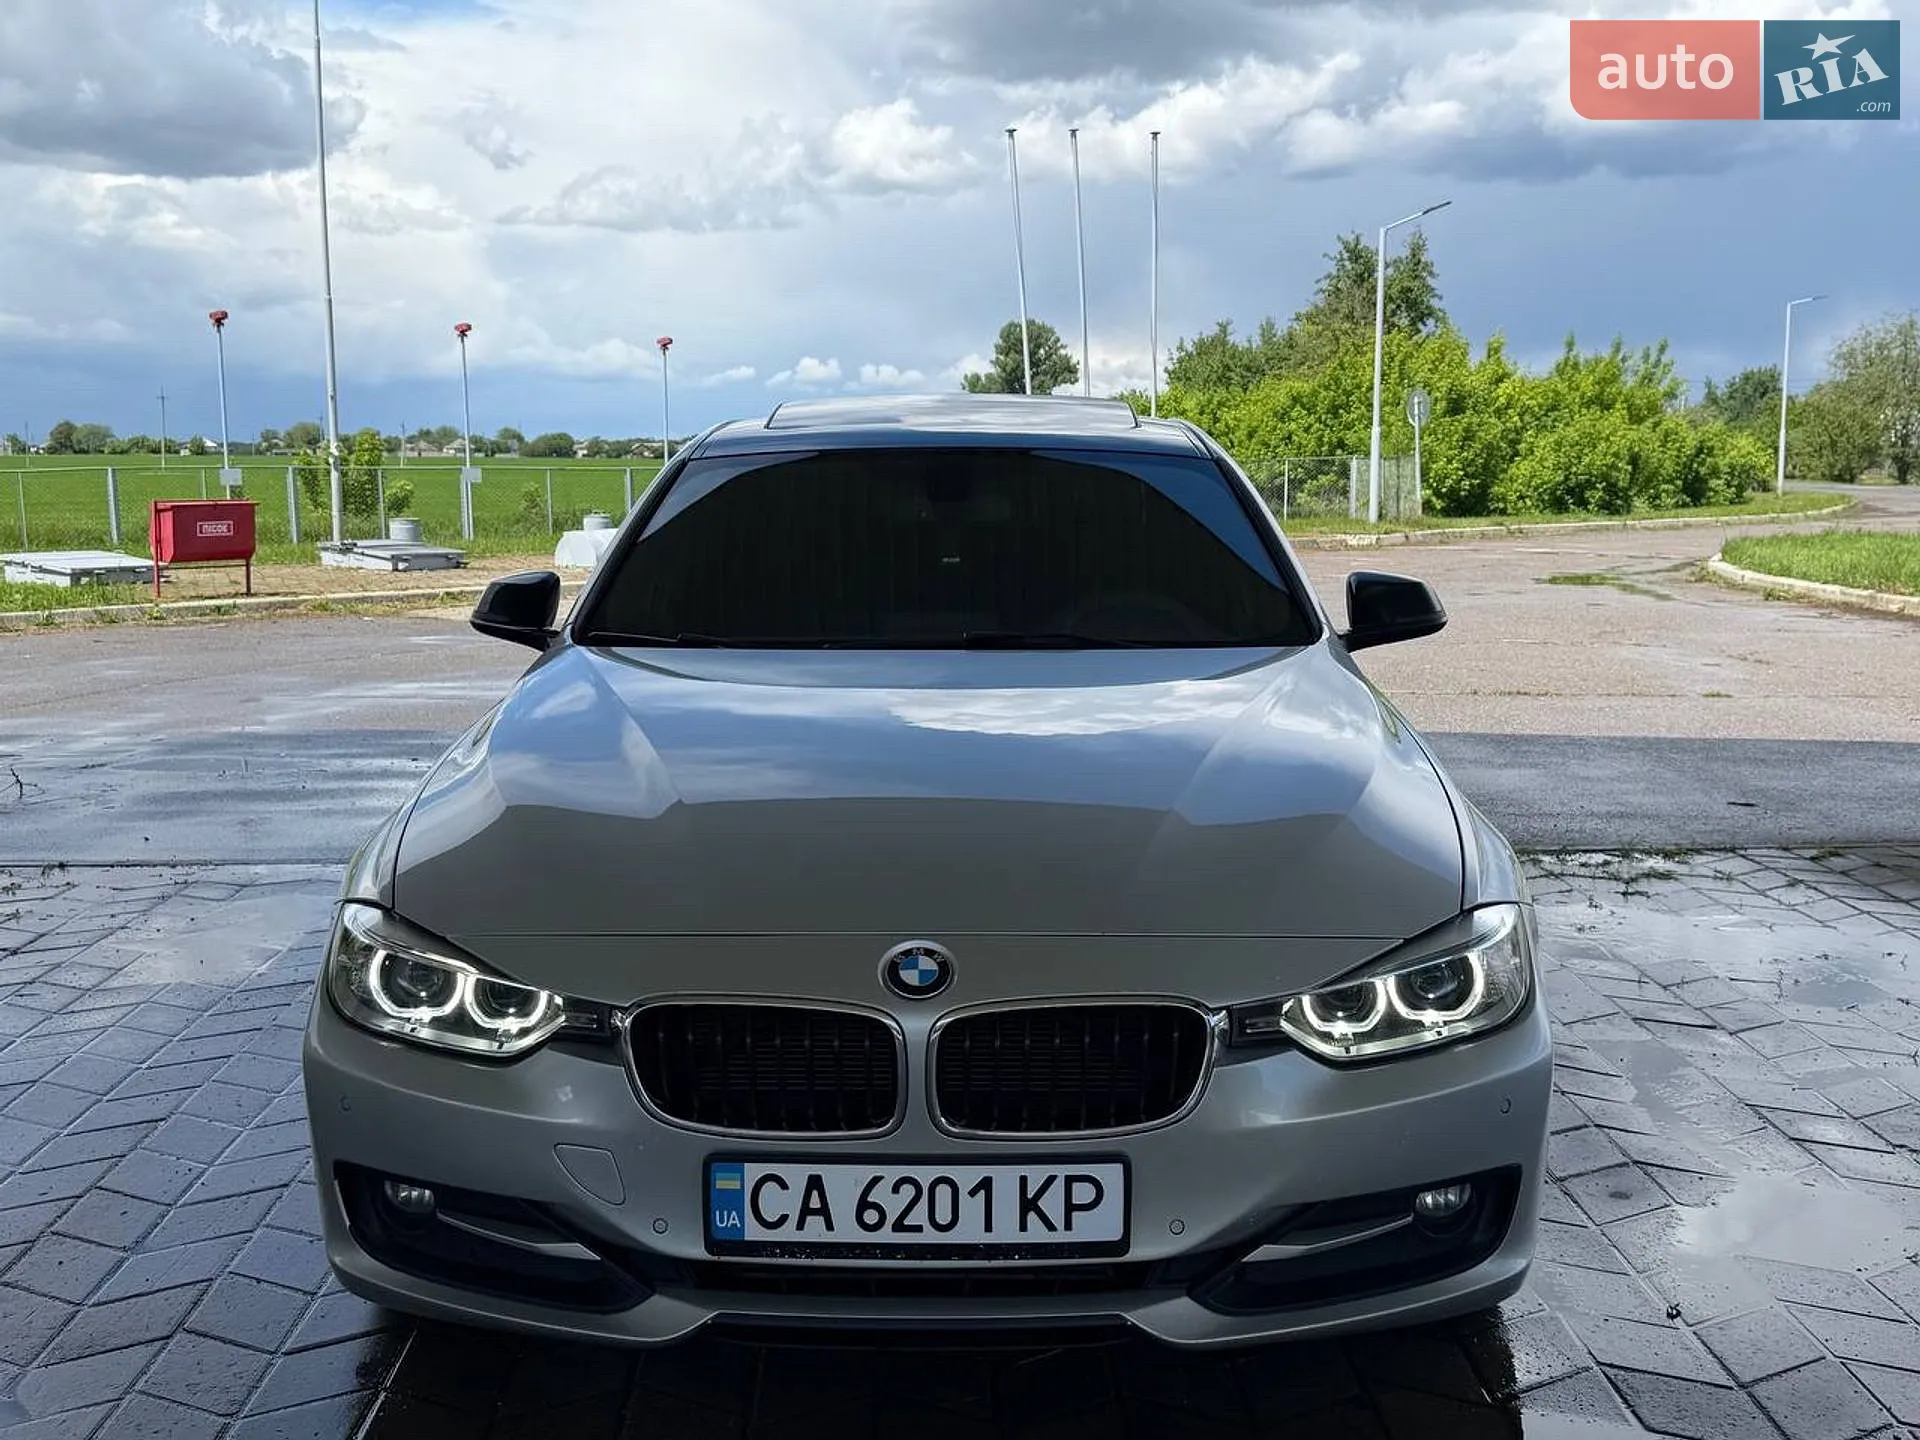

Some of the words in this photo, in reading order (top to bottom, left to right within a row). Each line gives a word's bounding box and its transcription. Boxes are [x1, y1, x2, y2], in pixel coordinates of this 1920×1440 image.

[715, 1210, 741, 1228] UA
[749, 1173, 835, 1232] CA
[855, 1174, 994, 1233] 6201
[1018, 1174, 1105, 1233] KP
